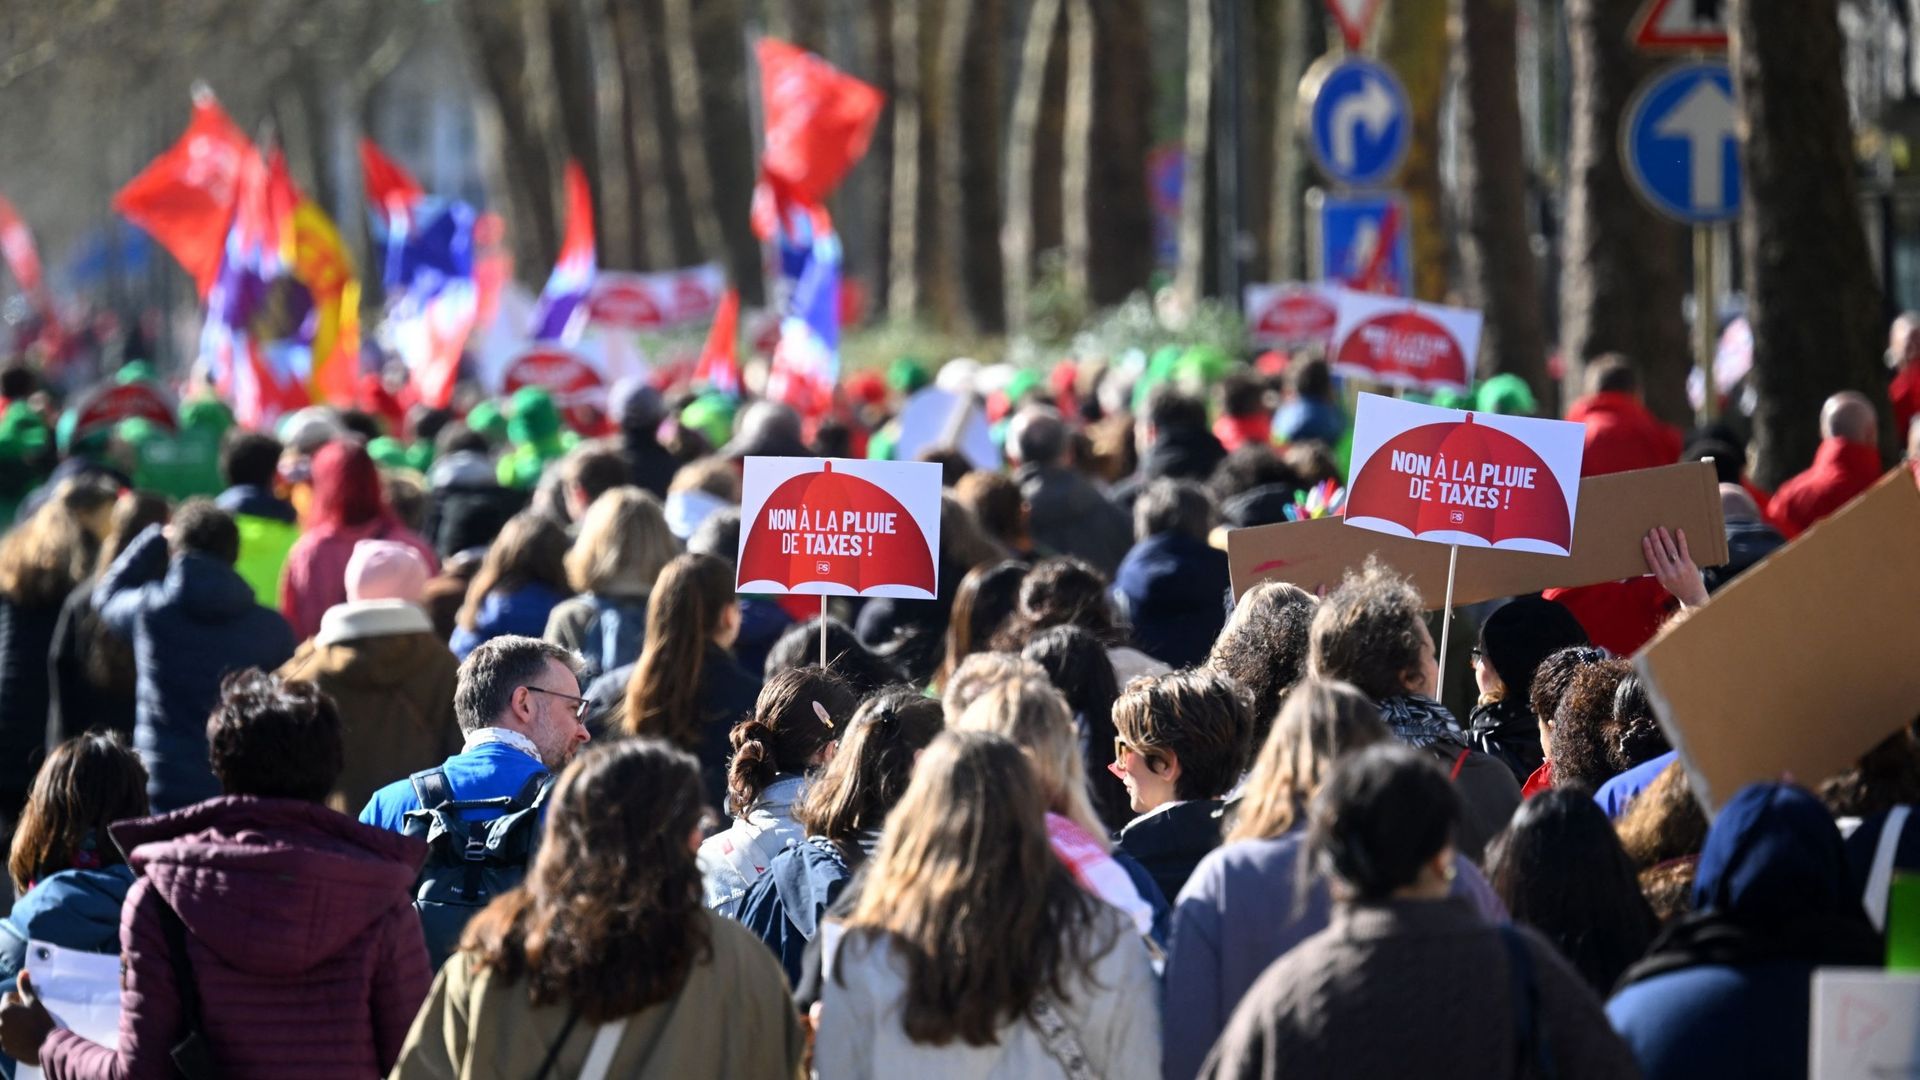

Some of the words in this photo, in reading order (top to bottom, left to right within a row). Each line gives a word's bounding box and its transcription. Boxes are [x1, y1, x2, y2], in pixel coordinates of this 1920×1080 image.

[1390, 449, 1431, 477] NON
[1434, 453, 1447, 480] À
[1452, 460, 1475, 483] LA
[1480, 463, 1537, 489] PLUIE
[1409, 478, 1434, 501] DE
[1439, 482, 1499, 509] TAXES
[1503, 489, 1510, 510] !
[769, 509, 796, 530] NON
[800, 504, 810, 530] À
[816, 510, 838, 532] LA
[843, 511, 897, 534] PLUIE
[782, 533, 800, 554] DE
[804, 533, 862, 556] TAXES
[867, 536, 873, 556] !
